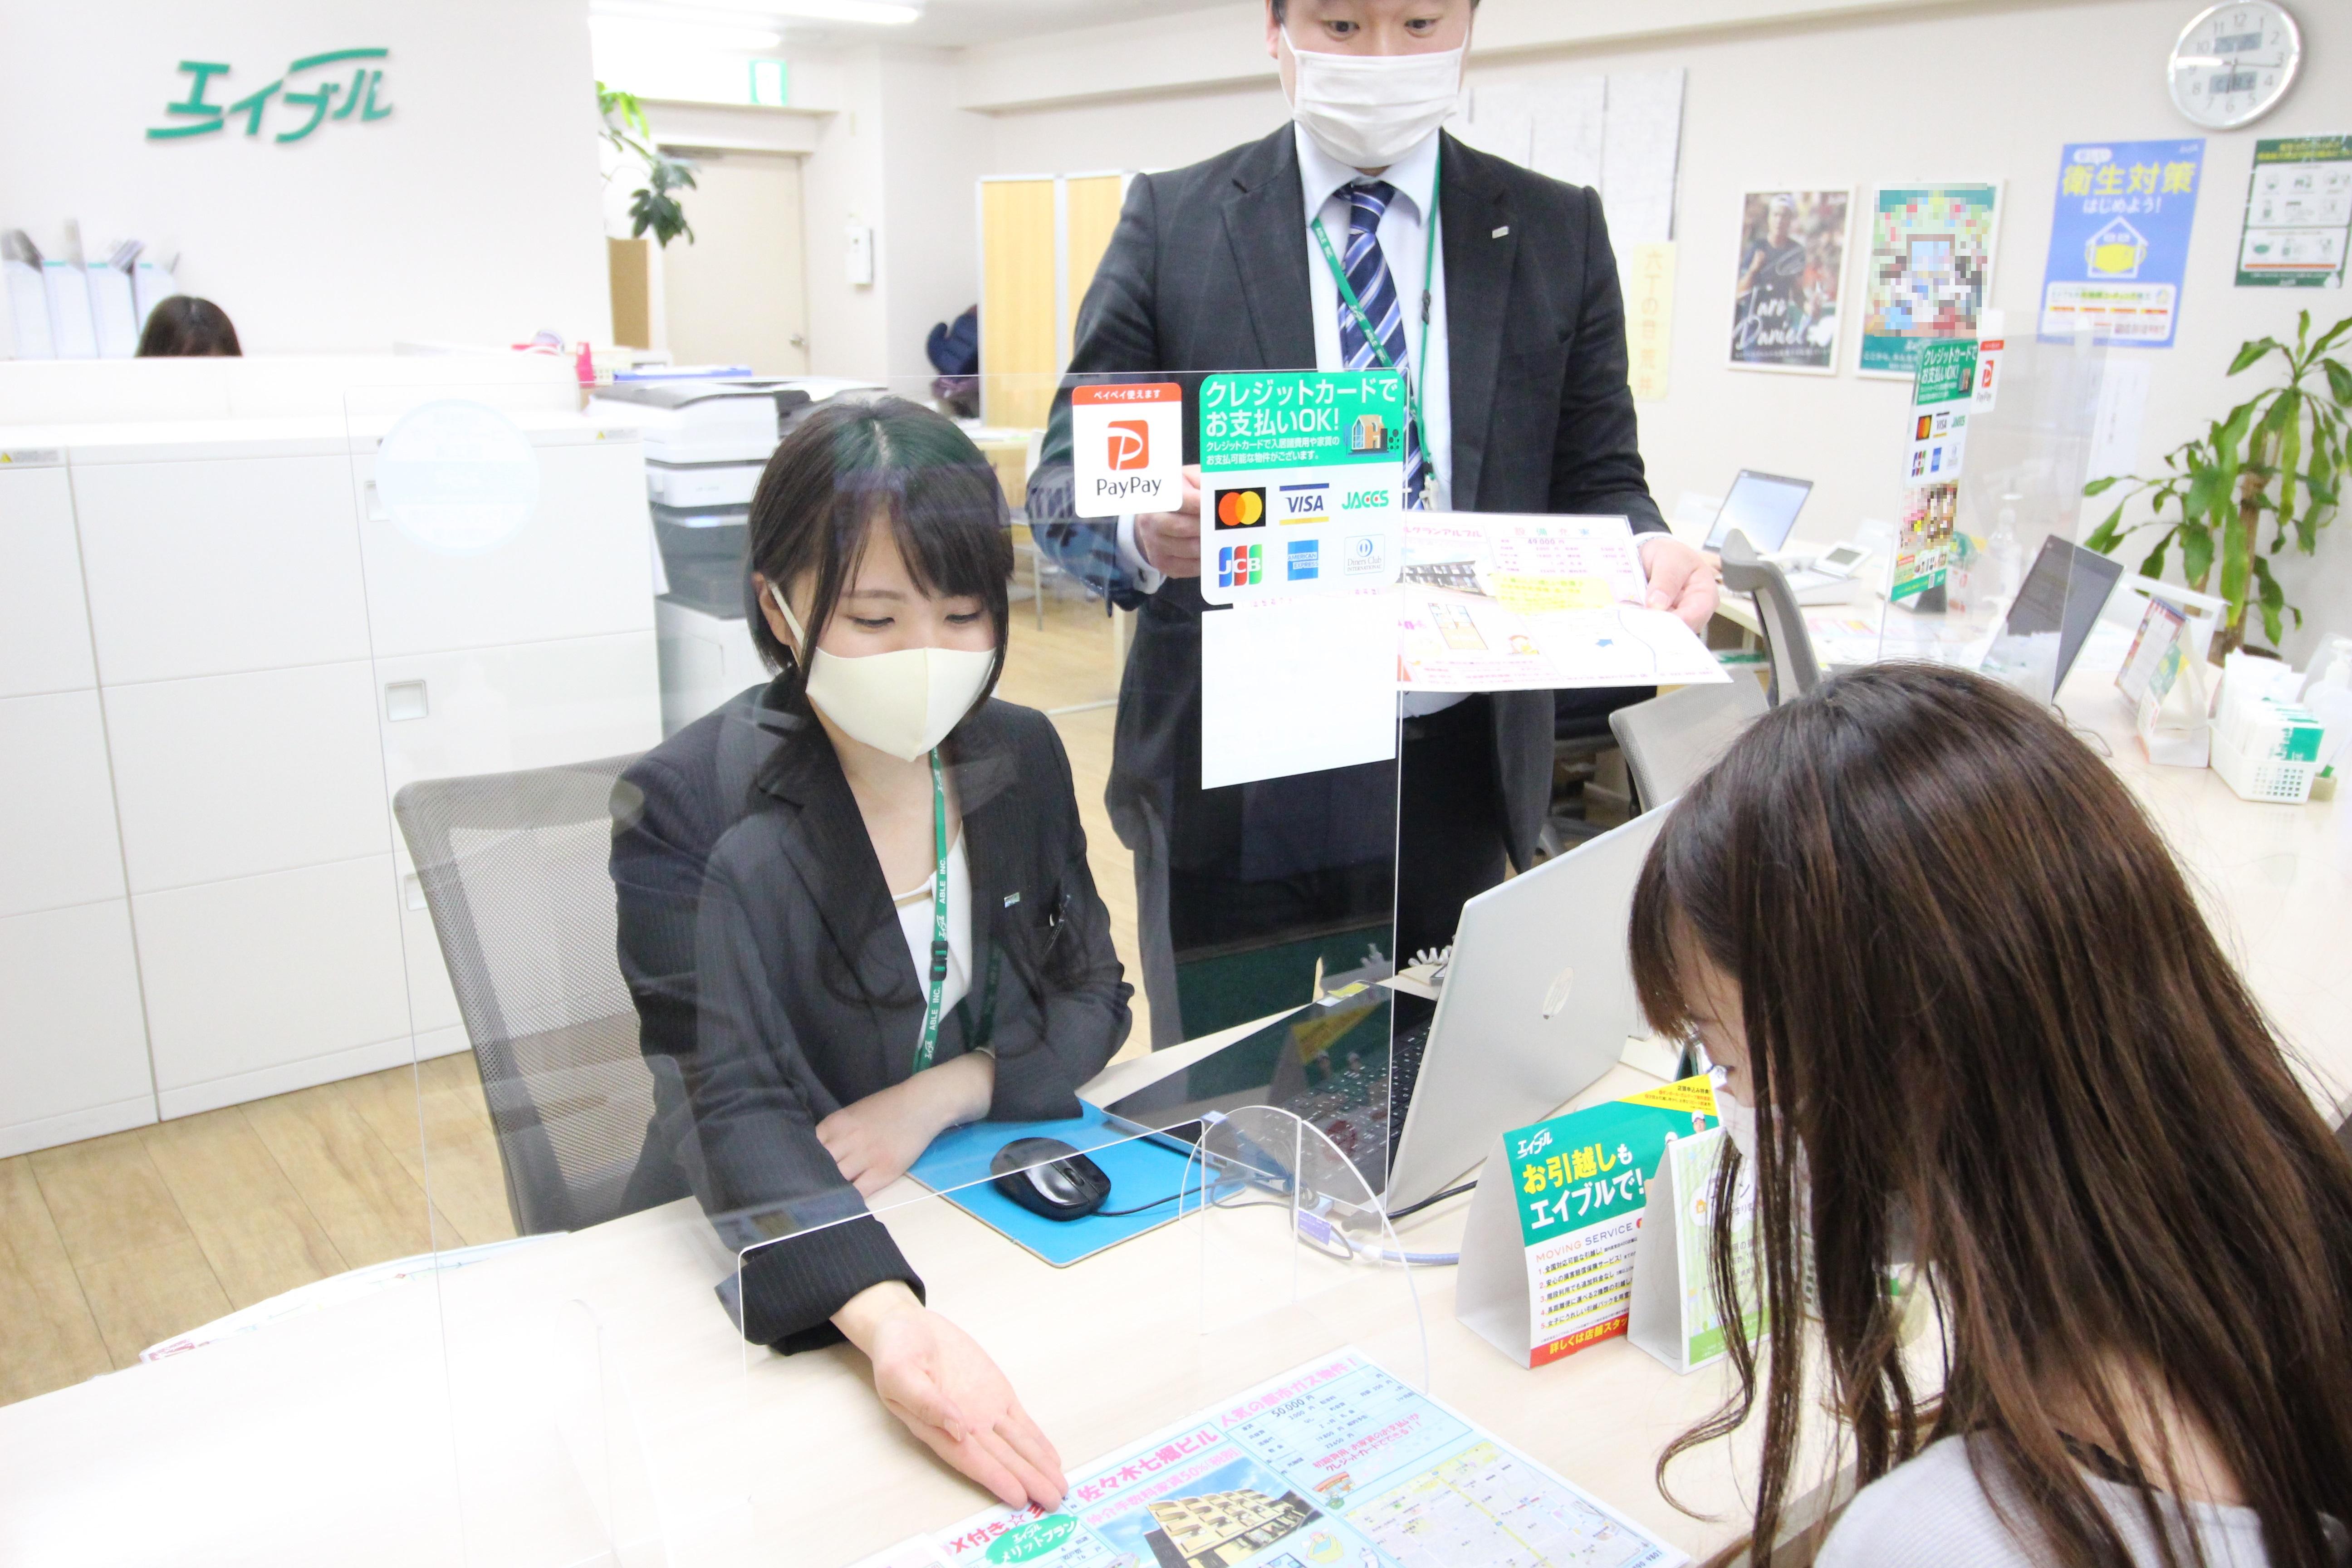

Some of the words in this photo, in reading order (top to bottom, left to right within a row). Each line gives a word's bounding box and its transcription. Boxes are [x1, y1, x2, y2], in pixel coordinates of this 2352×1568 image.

[145, 47, 394, 144] エイブル
[2063, 162, 2196, 196] 衛生対策
[1093, 390, 1161, 400] ペイペイ使えます
[1206, 377, 1398, 408] クレジットカードで
[1206, 407, 1339, 437] お支払いOK!
[1206, 437, 1340, 452] クレジットカードで入居諸費用や家賃の
[1206, 451, 1319, 466] お支払可能な物件がございます。
[1096, 476, 1162, 499] PayPay
[1342, 490, 1389, 510] JACCS
[1285, 495, 1324, 513] VISA
[1347, 564, 1382, 573] INTERNATIONAL
[1348, 557, 1366, 566] Diners
[1368, 556, 1382, 564] Club
[932, 987, 941, 1004] INC.
[929, 1009, 938, 1031] ABLE
[1516, 1127, 1553, 1160] エイブル
[1523, 1143, 1633, 1194] お引越しも
[1530, 1167, 1645, 1230] エイブルで!
[1536, 1240, 1583, 1263] MOVING
[1585, 1222, 1633, 1246] SERVICE
[1540, 1278, 1632, 1316] 4.長距離便に選べる2種類の引越し
[1541, 1291, 1631, 1329] 5.女子にうれしい引越パックを用意
